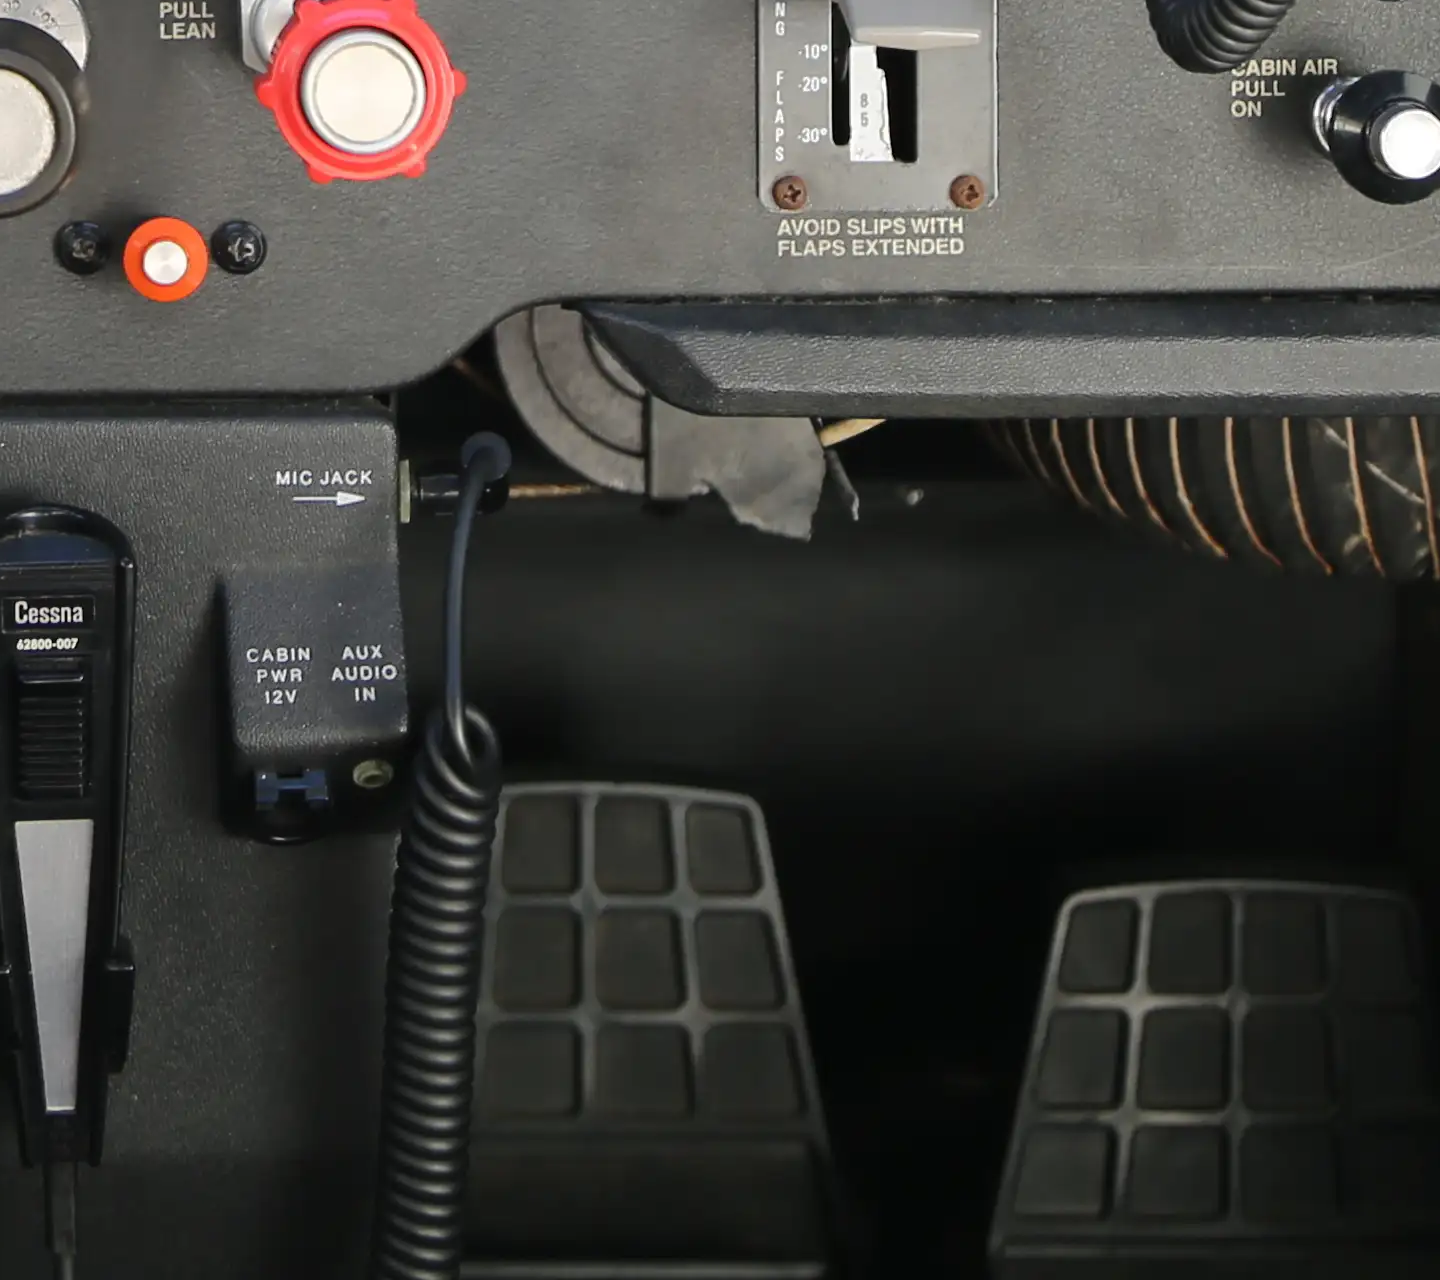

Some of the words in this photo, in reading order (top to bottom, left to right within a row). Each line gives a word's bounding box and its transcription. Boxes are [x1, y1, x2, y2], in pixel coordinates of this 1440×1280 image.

[159, 1, 214, 20] PULL
[159, 22, 216, 40] LEAN
[777, 218, 841, 236] AVOID
[846, 217, 906, 236] SLIPS
[910, 216, 964, 235] WITH
[777, 239, 846, 257] FLAPS
[851, 237, 964, 256] EXTENDED
[275, 470, 313, 486] MIC
[319, 469, 372, 486] JACK
[14, 600, 84, 625] Cessna
[16, 637, 79, 651] 62800-007
[342, 644, 383, 661] AUX
[246, 647, 310, 663] CABIN
[256, 667, 302, 684] PWR
[331, 664, 398, 682] AUDIO
[264, 689, 297, 705] 12V
[354, 686, 376, 702] IN
